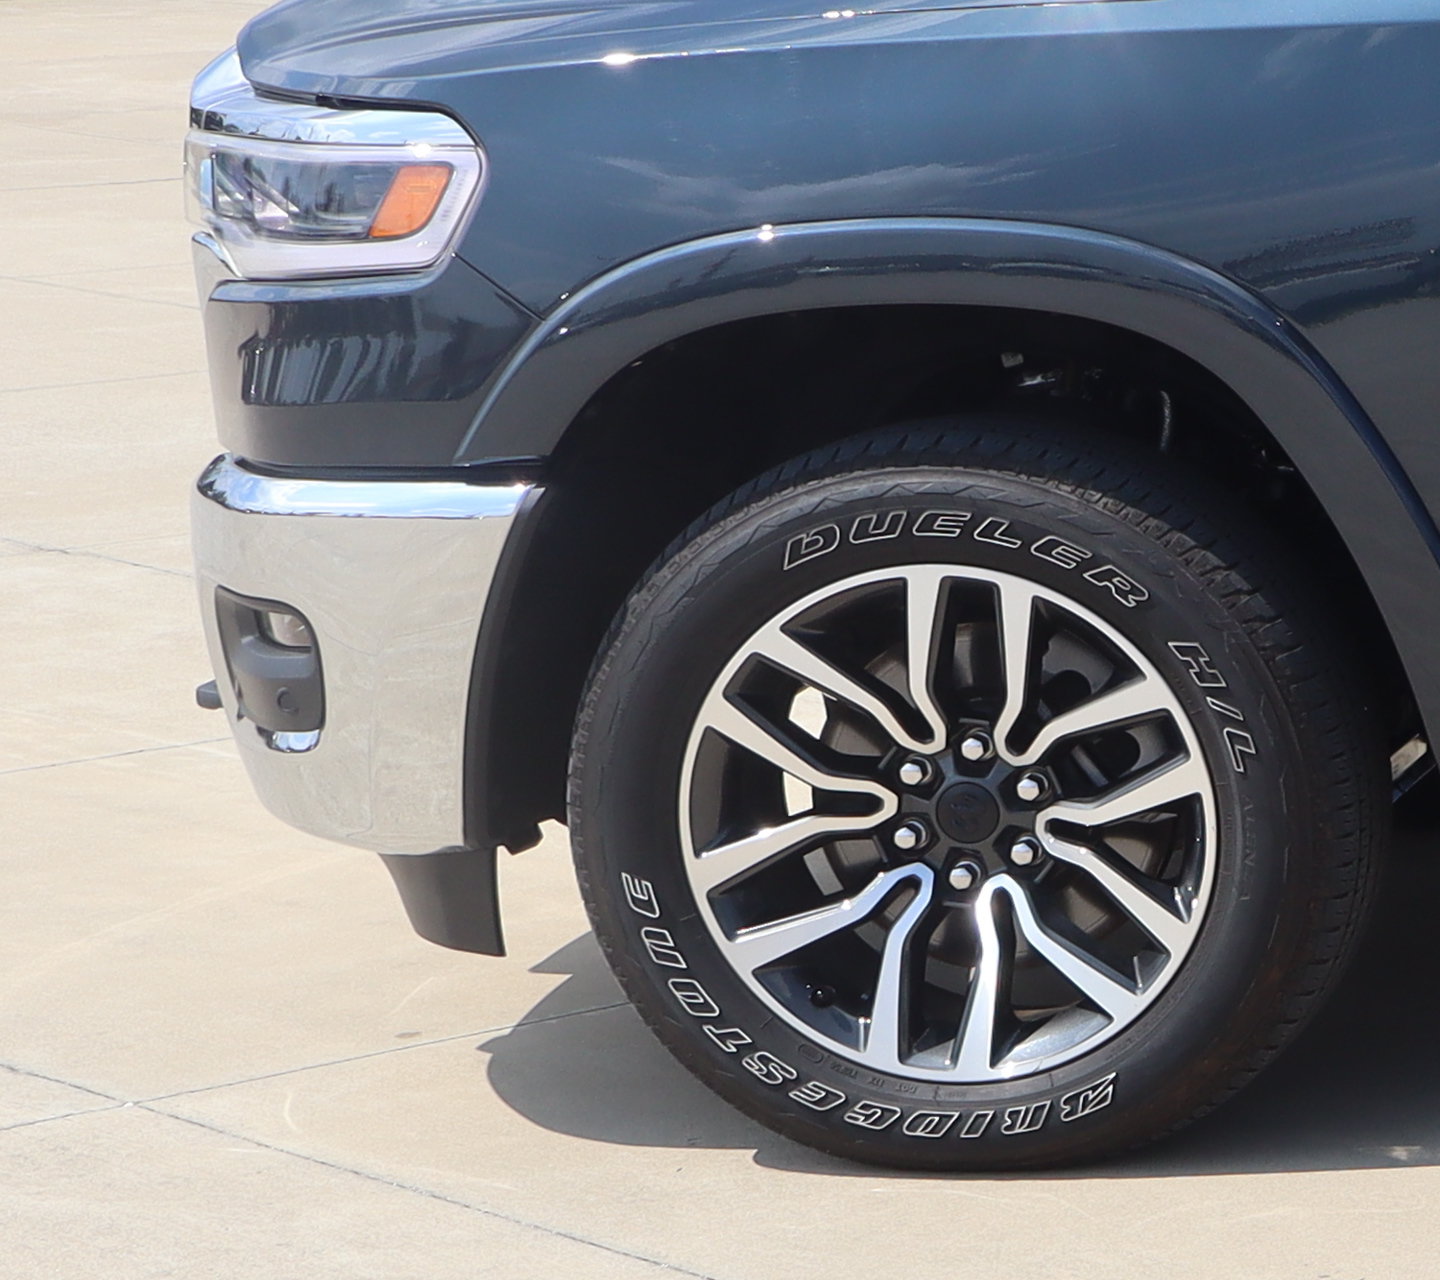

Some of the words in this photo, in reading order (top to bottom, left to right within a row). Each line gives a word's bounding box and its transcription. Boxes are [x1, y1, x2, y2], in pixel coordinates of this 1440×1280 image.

[783, 510, 1150, 609] DUELER
[1167, 640, 1258, 774] H/L
[621, 871, 1118, 1138] BRIDGESTONE
